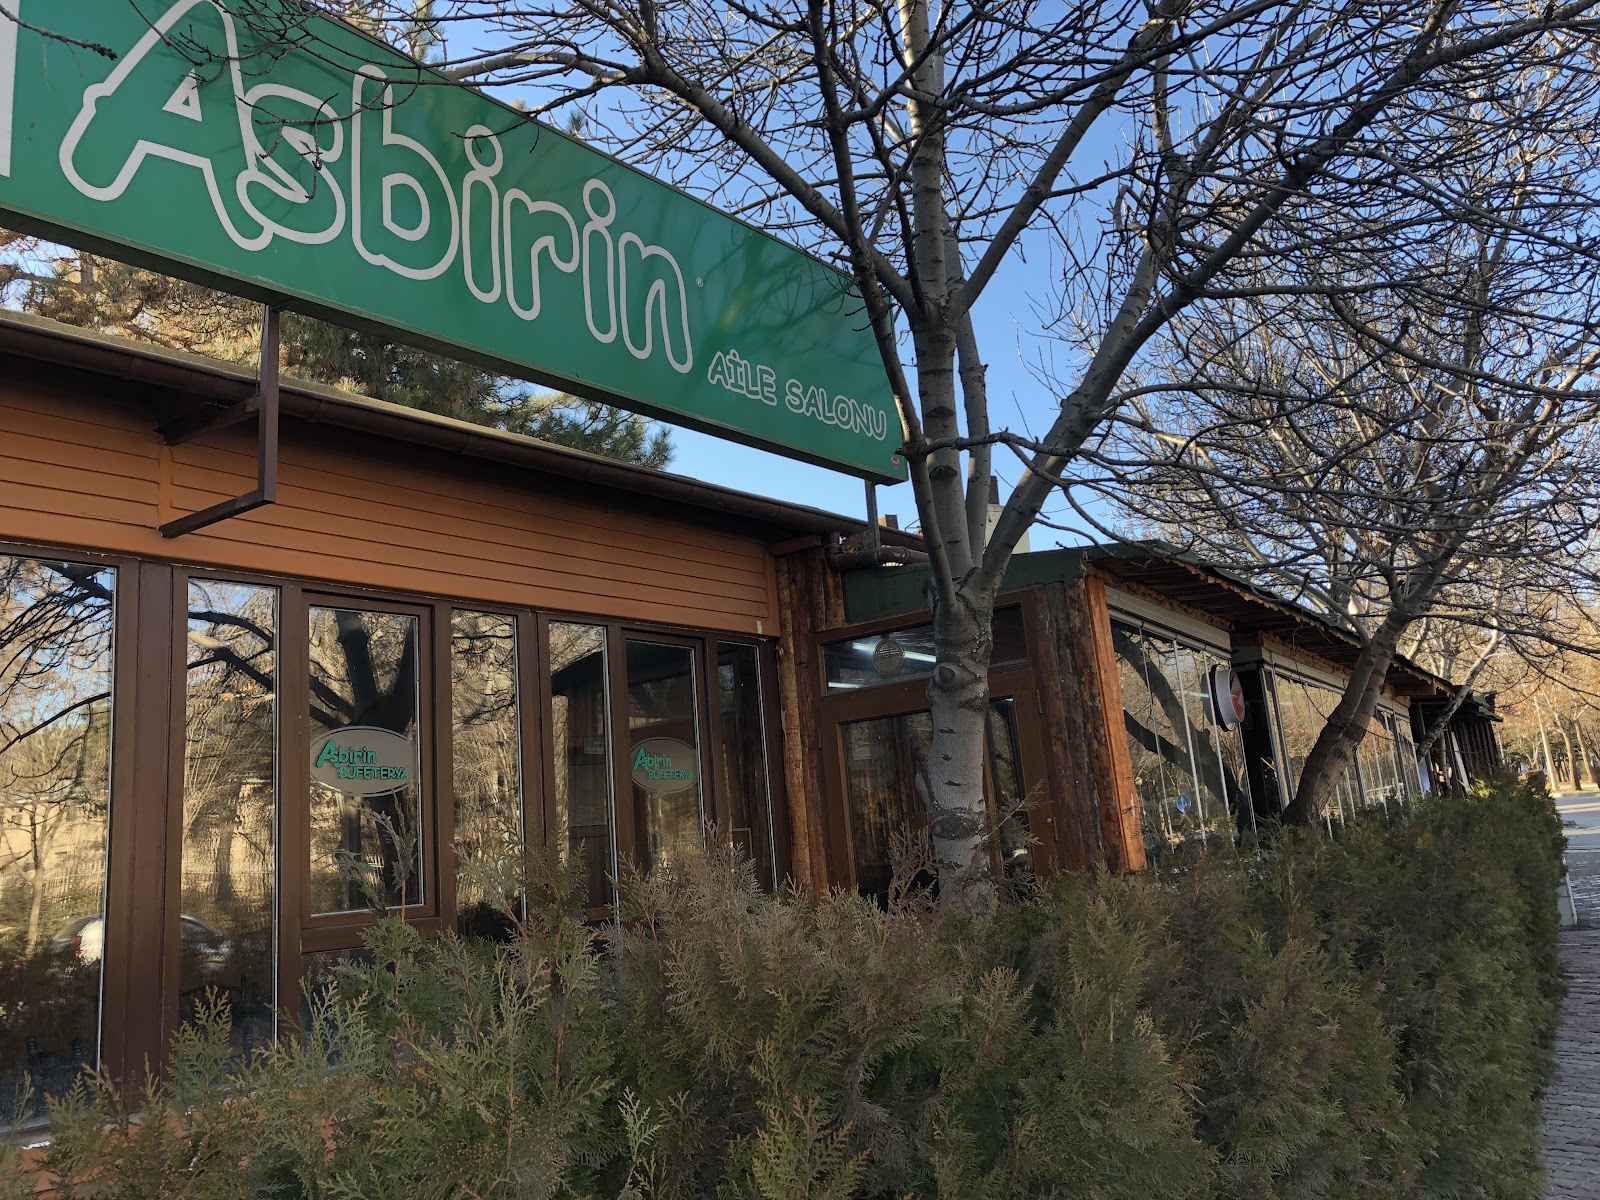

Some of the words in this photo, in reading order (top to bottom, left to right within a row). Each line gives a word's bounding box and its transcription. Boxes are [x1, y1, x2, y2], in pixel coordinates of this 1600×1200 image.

[59, 0, 693, 374] Asbirin
[708, 349, 777, 406] AİLE
[785, 379, 887, 441] SALONU
[316, 738, 376, 768] Asbirin
[633, 747, 673, 771] Asbirin
